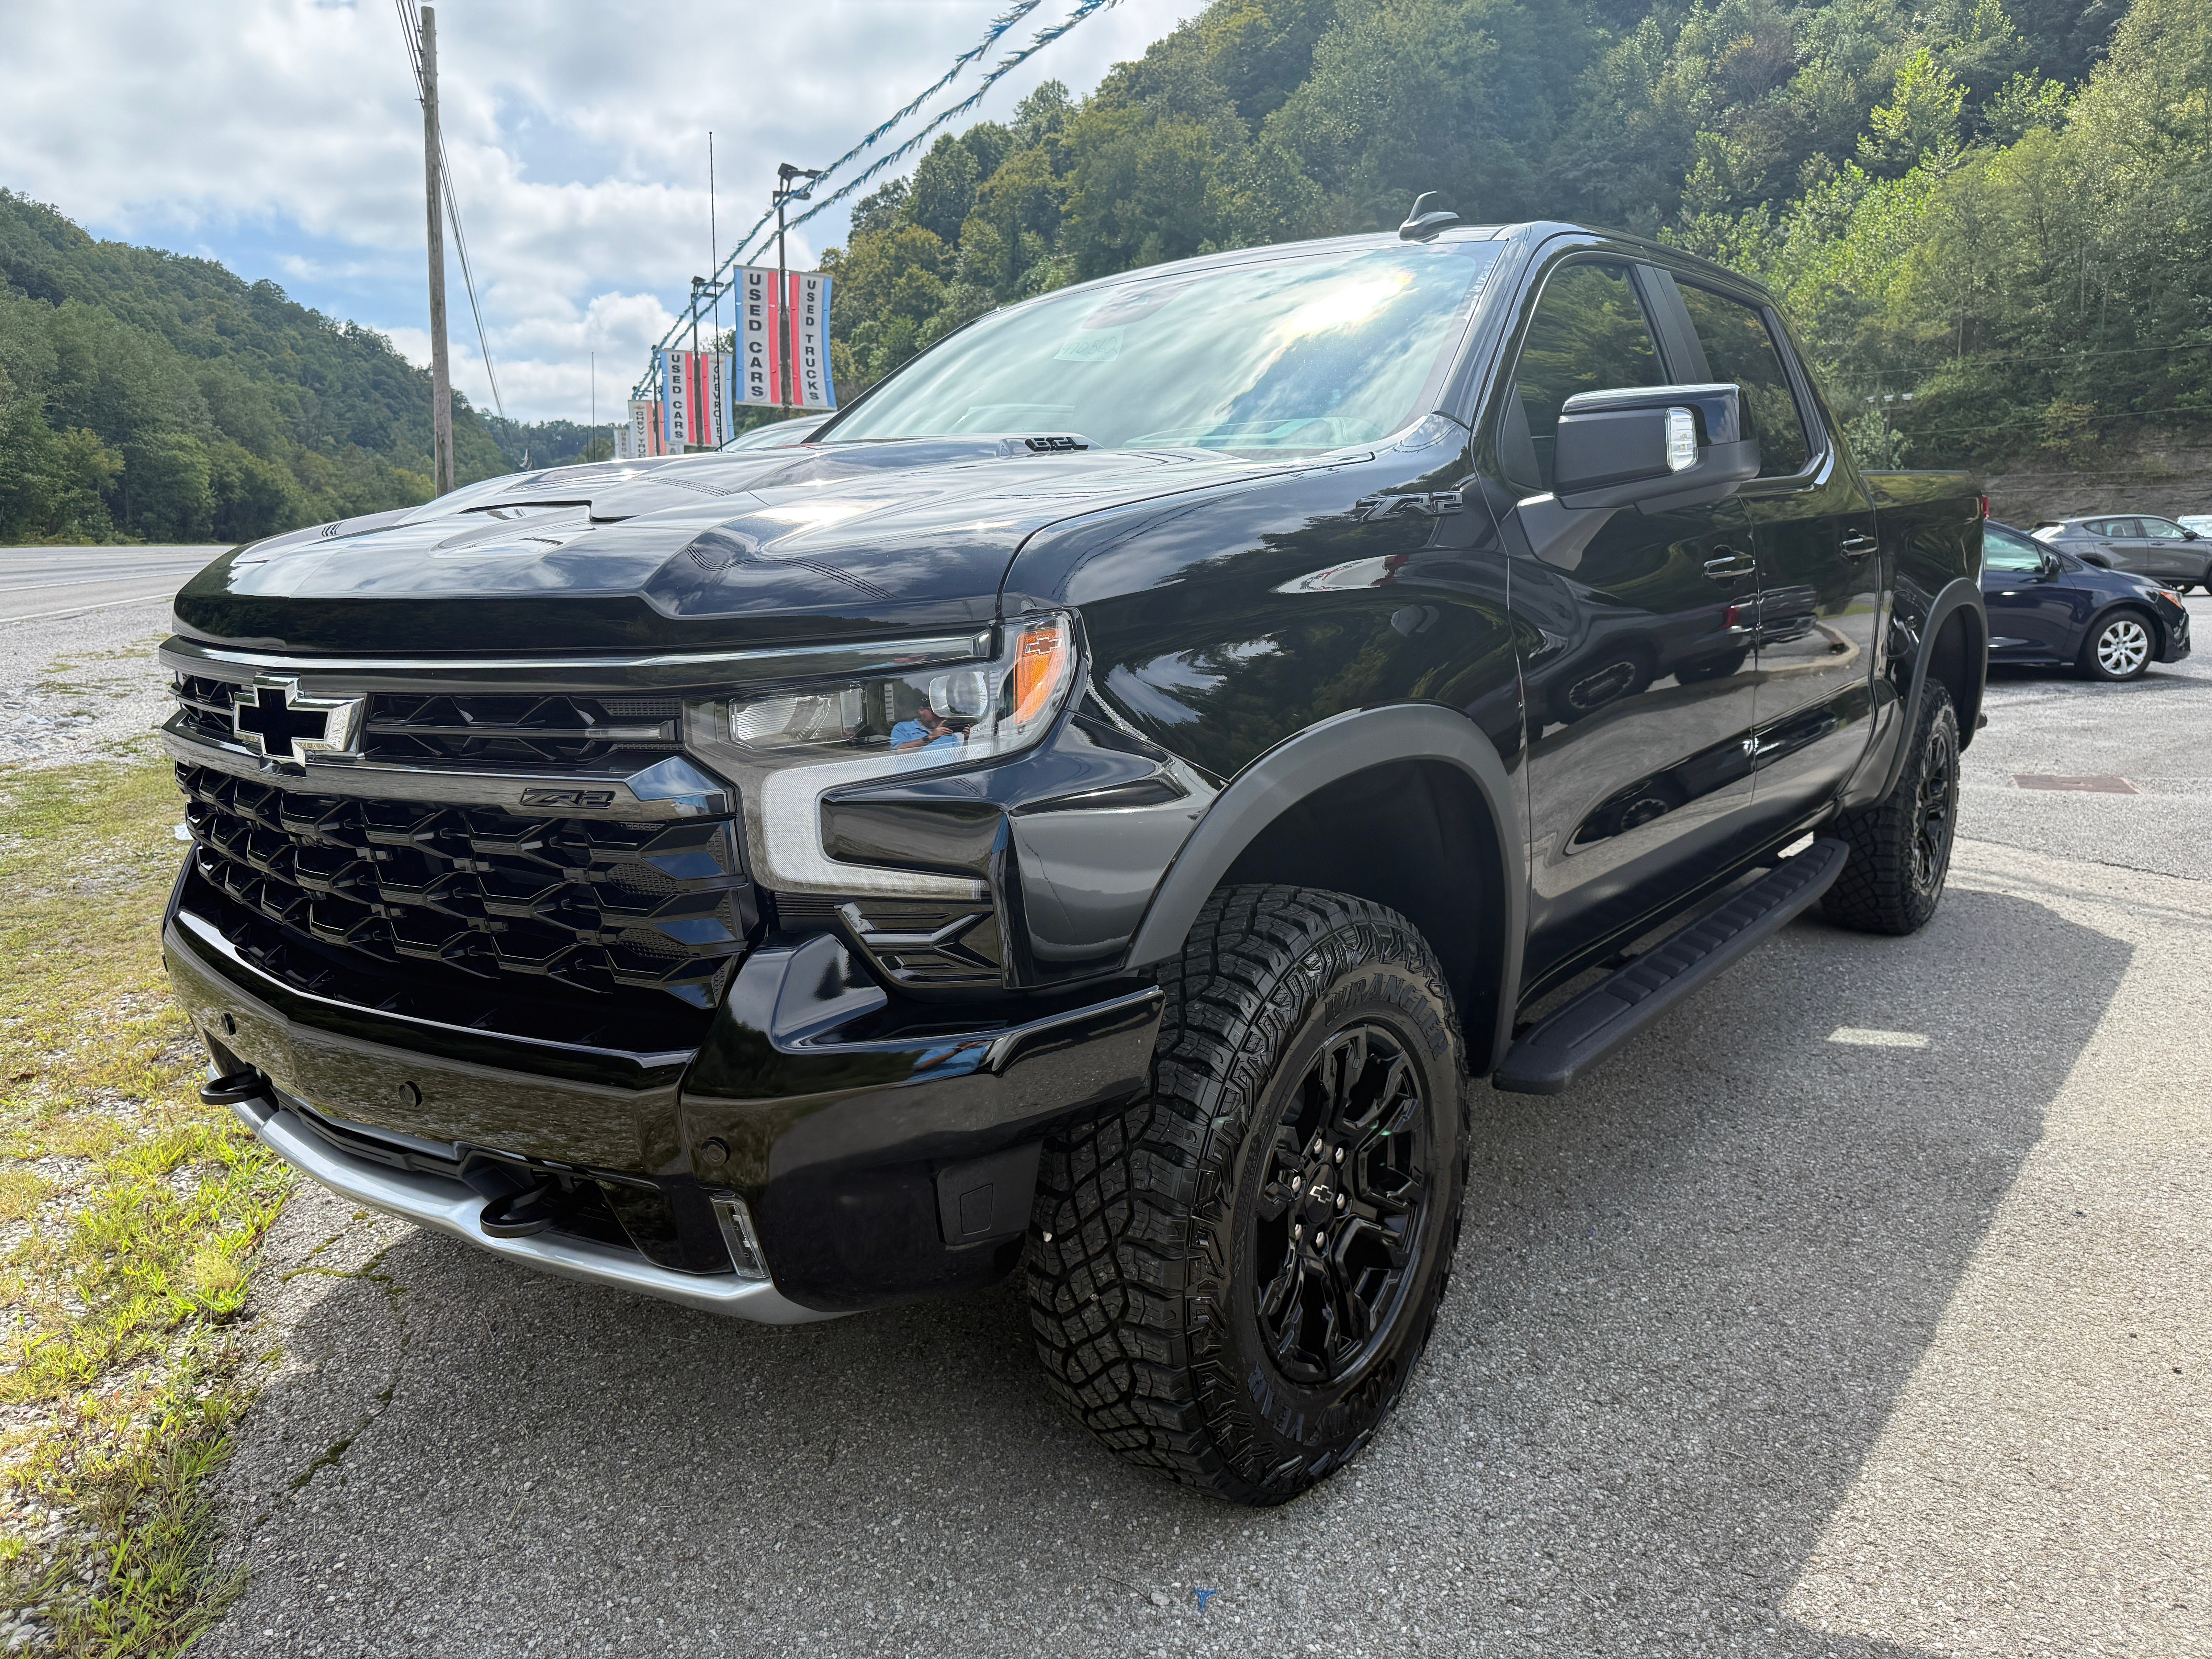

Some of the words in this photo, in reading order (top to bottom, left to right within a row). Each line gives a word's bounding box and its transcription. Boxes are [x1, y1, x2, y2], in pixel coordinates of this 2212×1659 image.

[749, 273, 762, 331] USED
[806, 280, 816, 326] USED
[672, 354, 682, 393] USED
[749, 342, 763, 397] CARS
[805, 334, 819, 400] TRUCKS
[636, 411, 644, 435] CHEVY
[673, 401, 684, 438] CARS
[1355, 491, 1463, 523] ZR2
[520, 788, 616, 809] ZR2
[1324, 972, 1448, 1061] WRANGLER
